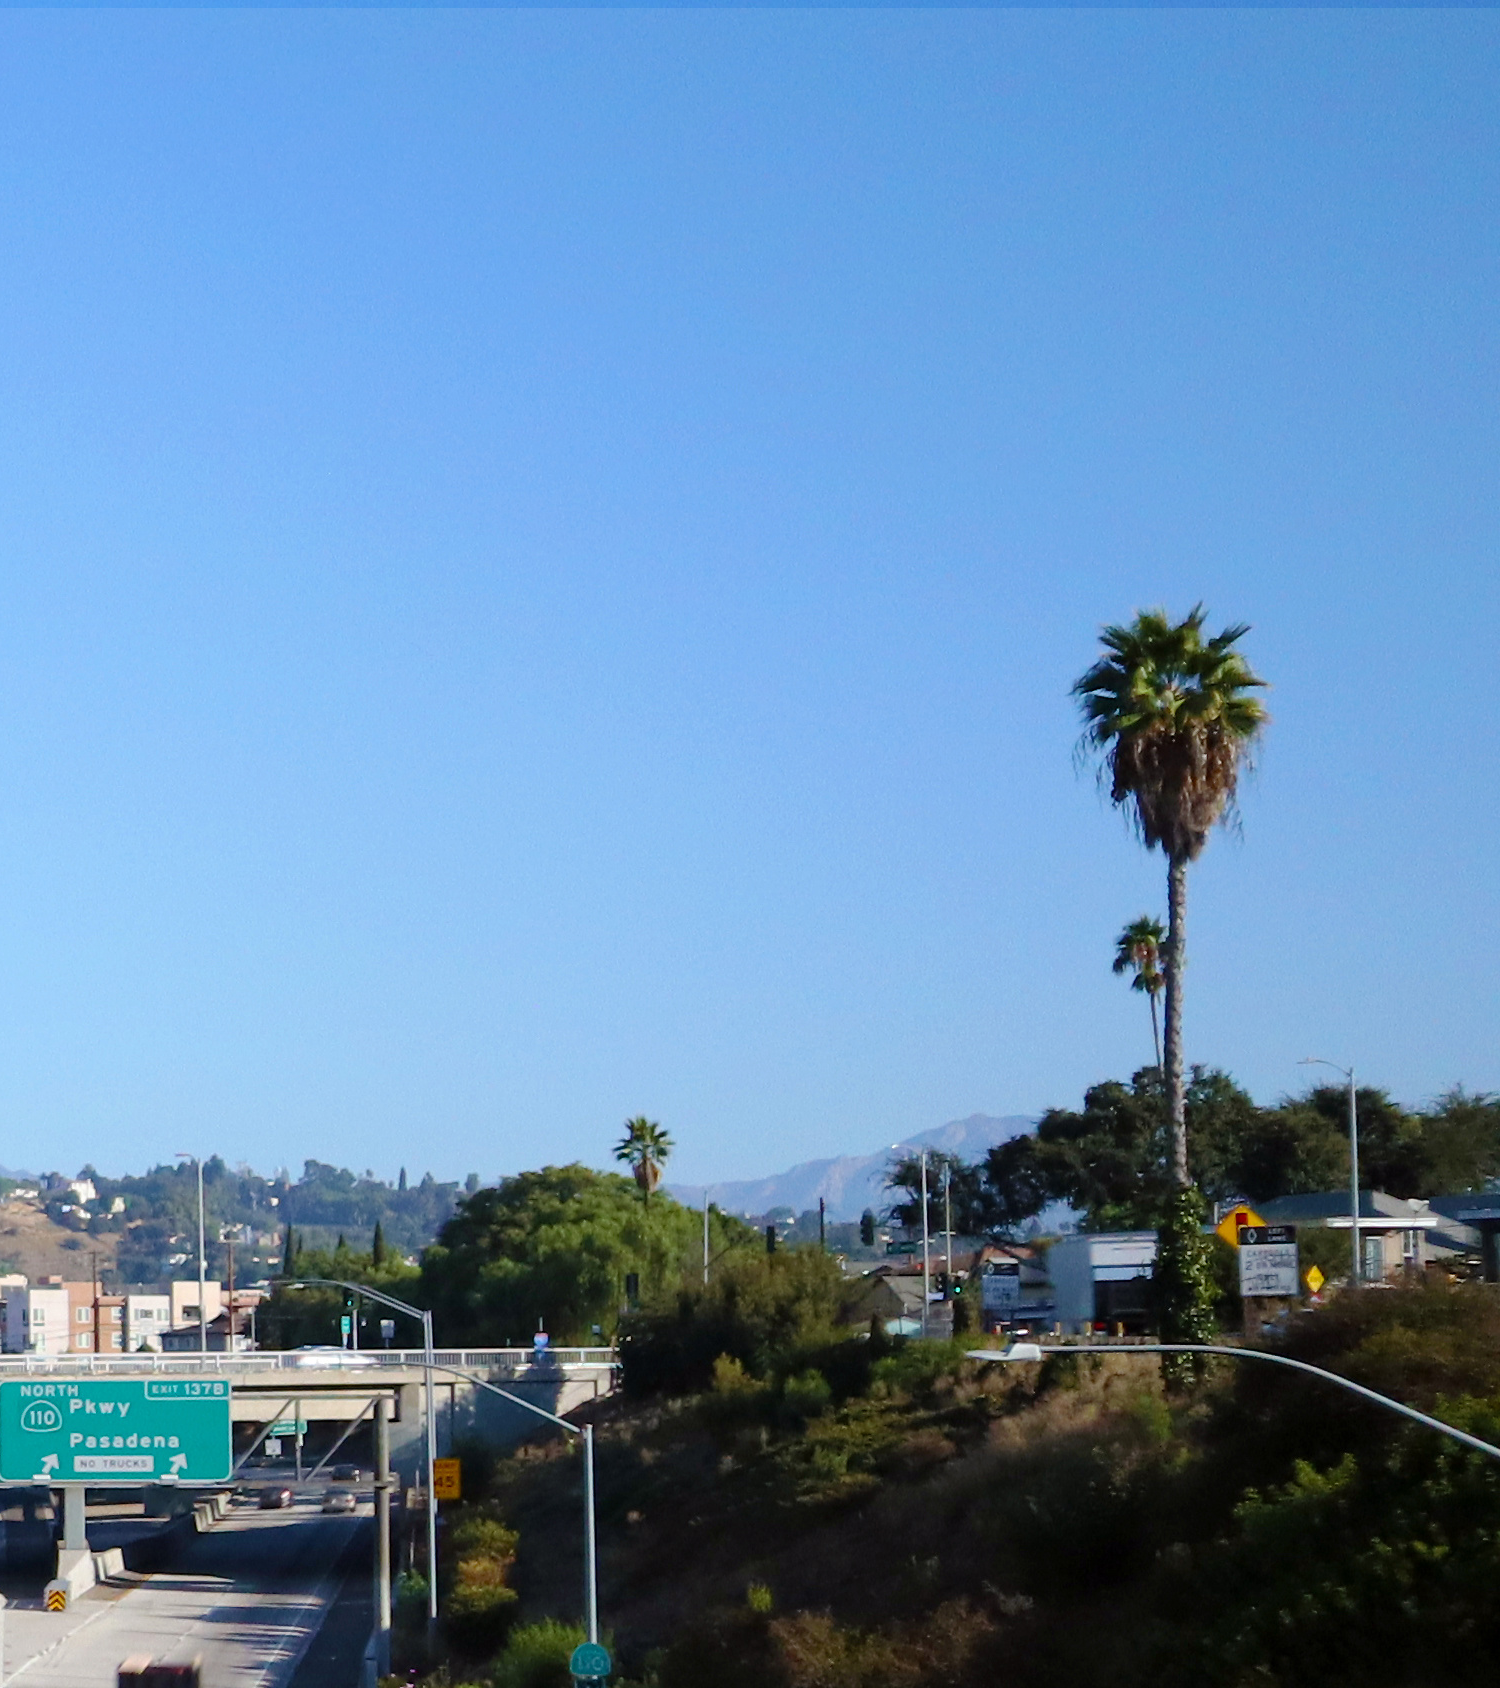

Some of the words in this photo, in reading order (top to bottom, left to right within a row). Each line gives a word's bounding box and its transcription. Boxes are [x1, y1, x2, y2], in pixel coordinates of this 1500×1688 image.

[20, 1384, 79, 1397] NORTH
[152, 1385, 178, 1394] EXIT
[184, 1383, 225, 1395] 137B
[69, 1398, 131, 1417] Pkwy
[30, 1410, 55, 1426] 110
[69, 1432, 180, 1449] Pasadena
[80, 1459, 96, 1468] NO
[102, 1459, 148, 1468] TRUCKS
